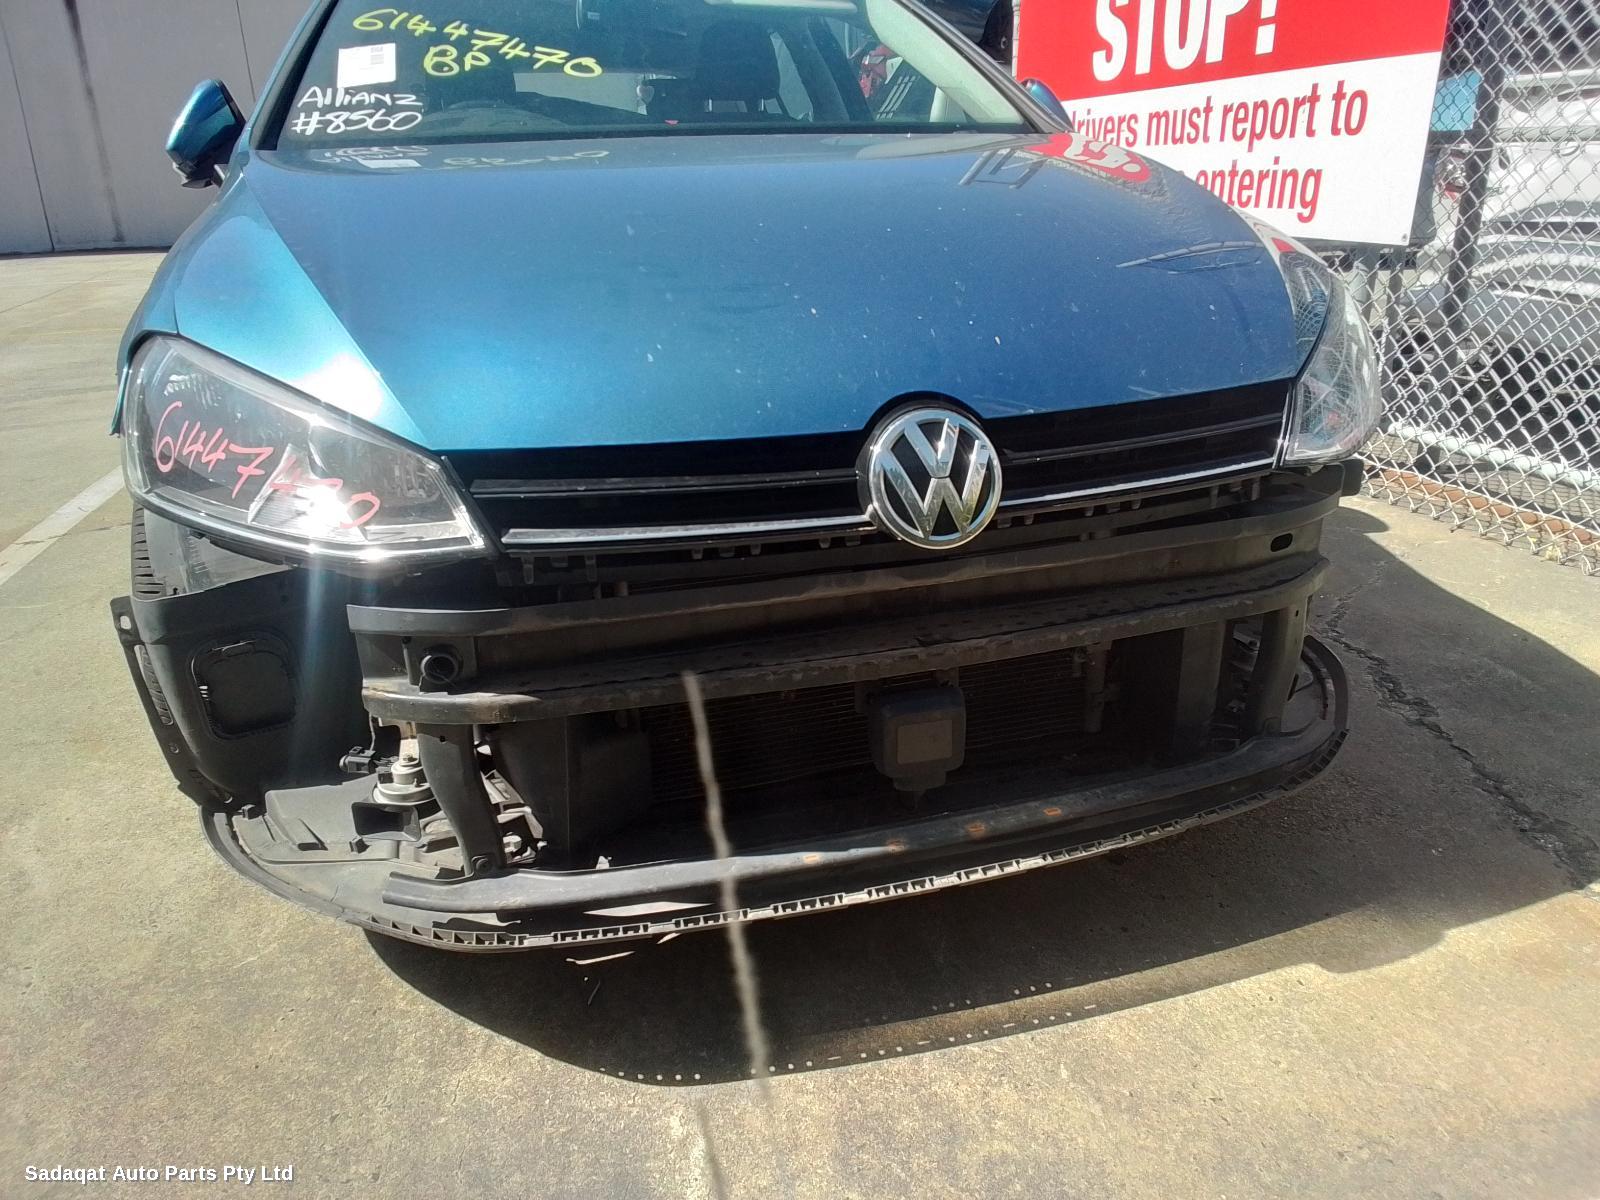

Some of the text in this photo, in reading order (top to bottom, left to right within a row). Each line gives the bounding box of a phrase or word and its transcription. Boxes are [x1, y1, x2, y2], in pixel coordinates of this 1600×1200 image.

[1092, 0, 1278, 82] STOP!
[291, 110, 423, 136] #8560
[1071, 79, 1369, 153] rivers must report to
